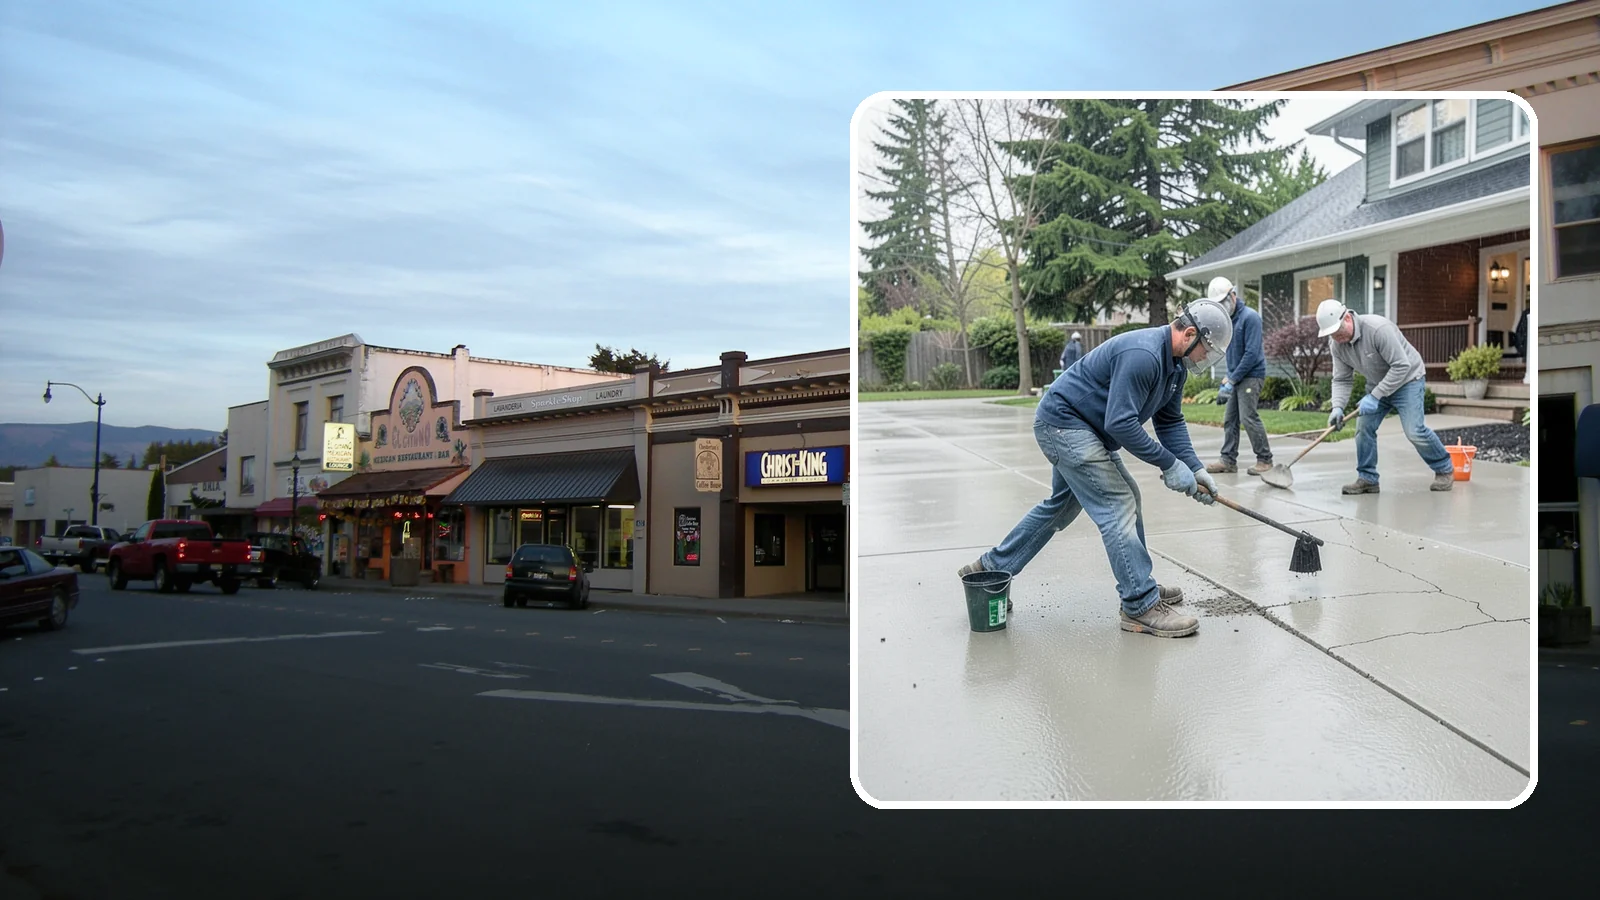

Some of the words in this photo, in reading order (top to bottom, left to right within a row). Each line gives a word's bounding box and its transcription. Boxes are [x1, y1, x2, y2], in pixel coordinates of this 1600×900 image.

[493, 403, 522, 412] LAVANDERIA
[531, 396, 559, 408] Sparkle
[561, 394, 583, 404] Shop
[595, 389, 623, 400] LAUNDRY
[373, 454, 396, 464] MEXICAN
[397, 451, 433, 462] RESTAURANT
[437, 450, 450, 459] BAR
[761, 452, 797, 478] CHRIST
[799, 450, 827, 476] KING
